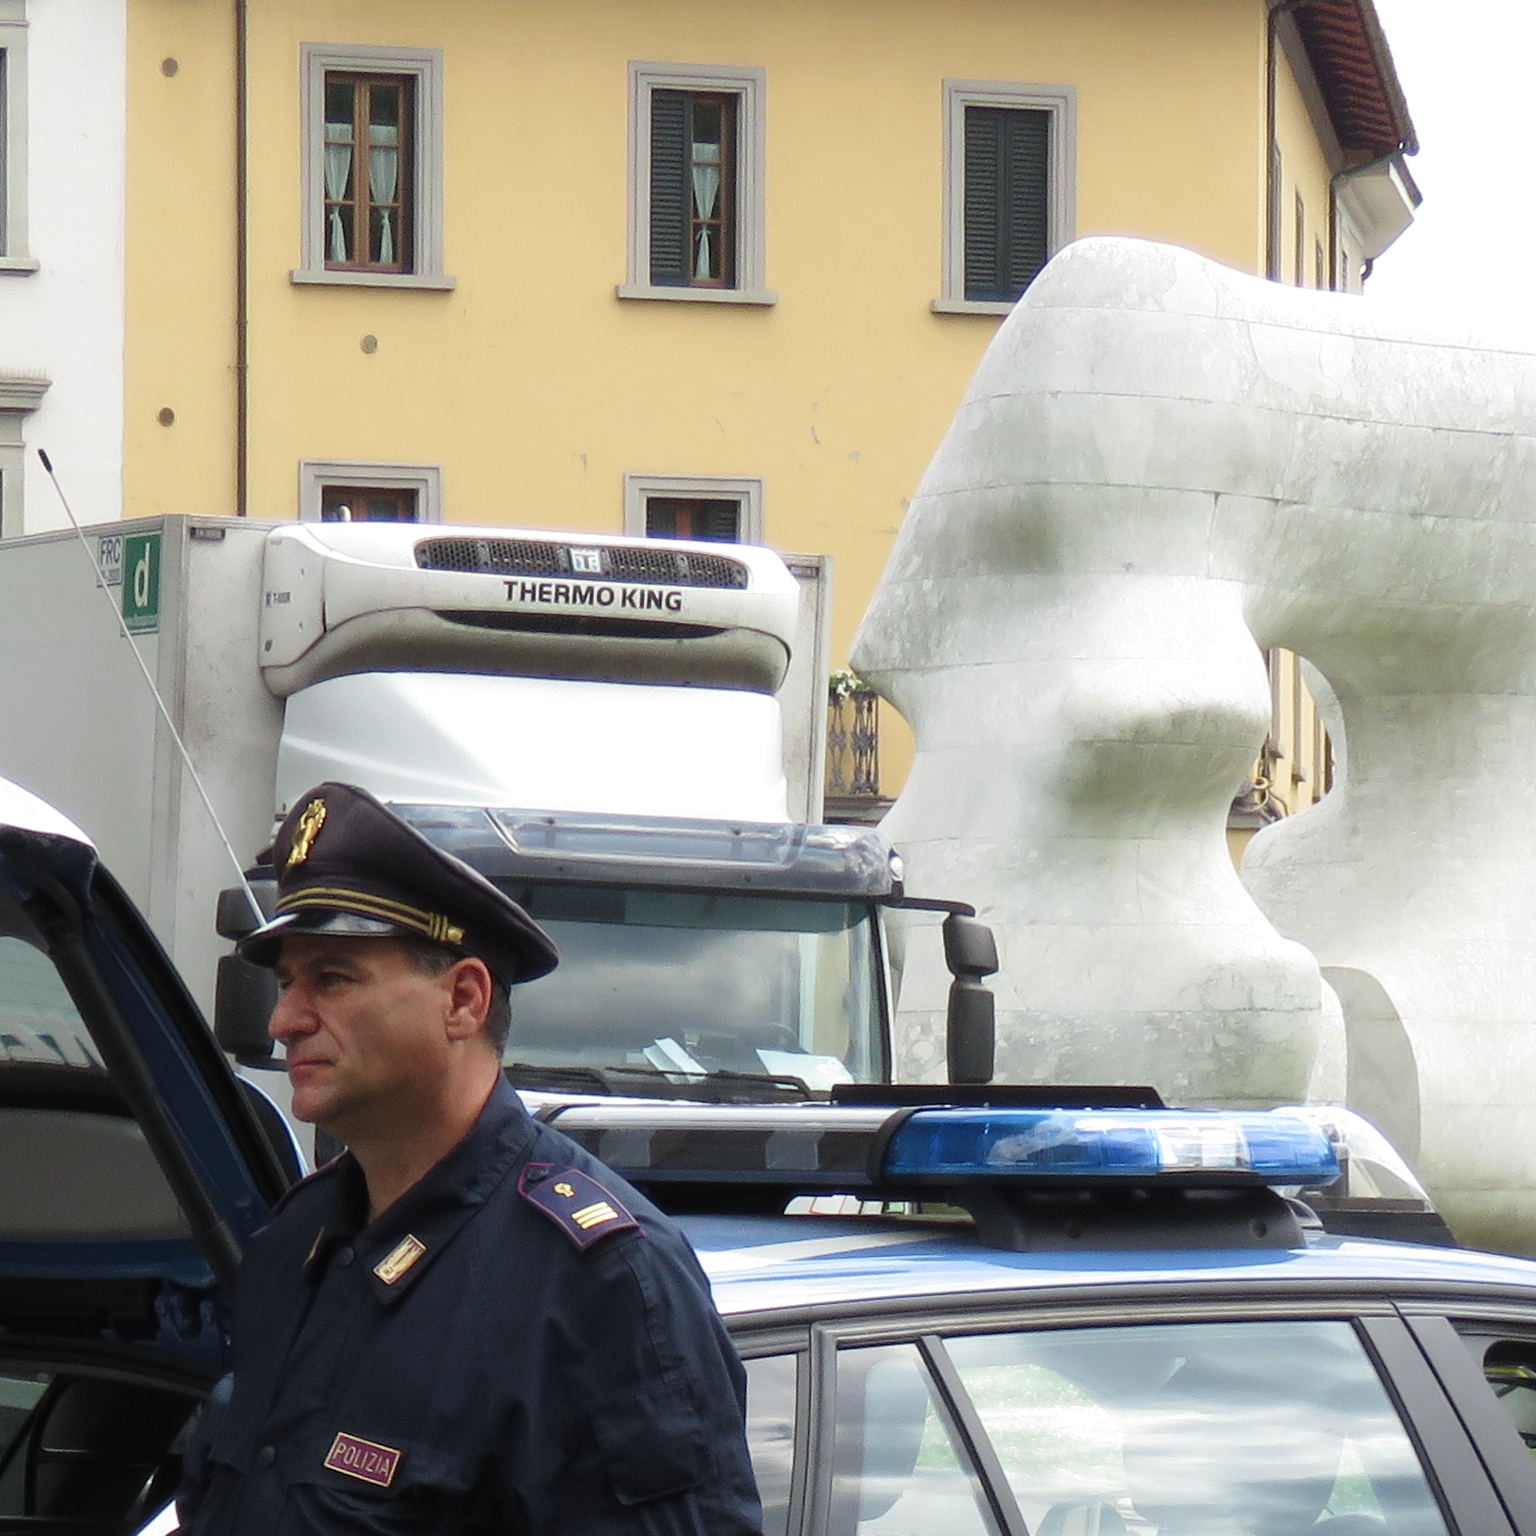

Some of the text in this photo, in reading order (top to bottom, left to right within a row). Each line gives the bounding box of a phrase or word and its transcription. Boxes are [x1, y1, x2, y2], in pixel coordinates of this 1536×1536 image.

[100, 538, 122, 566] FRC
[134, 542, 150, 607] d
[503, 580, 683, 612] THERMO KING
[332, 1442, 391, 1477] POLIZIA
